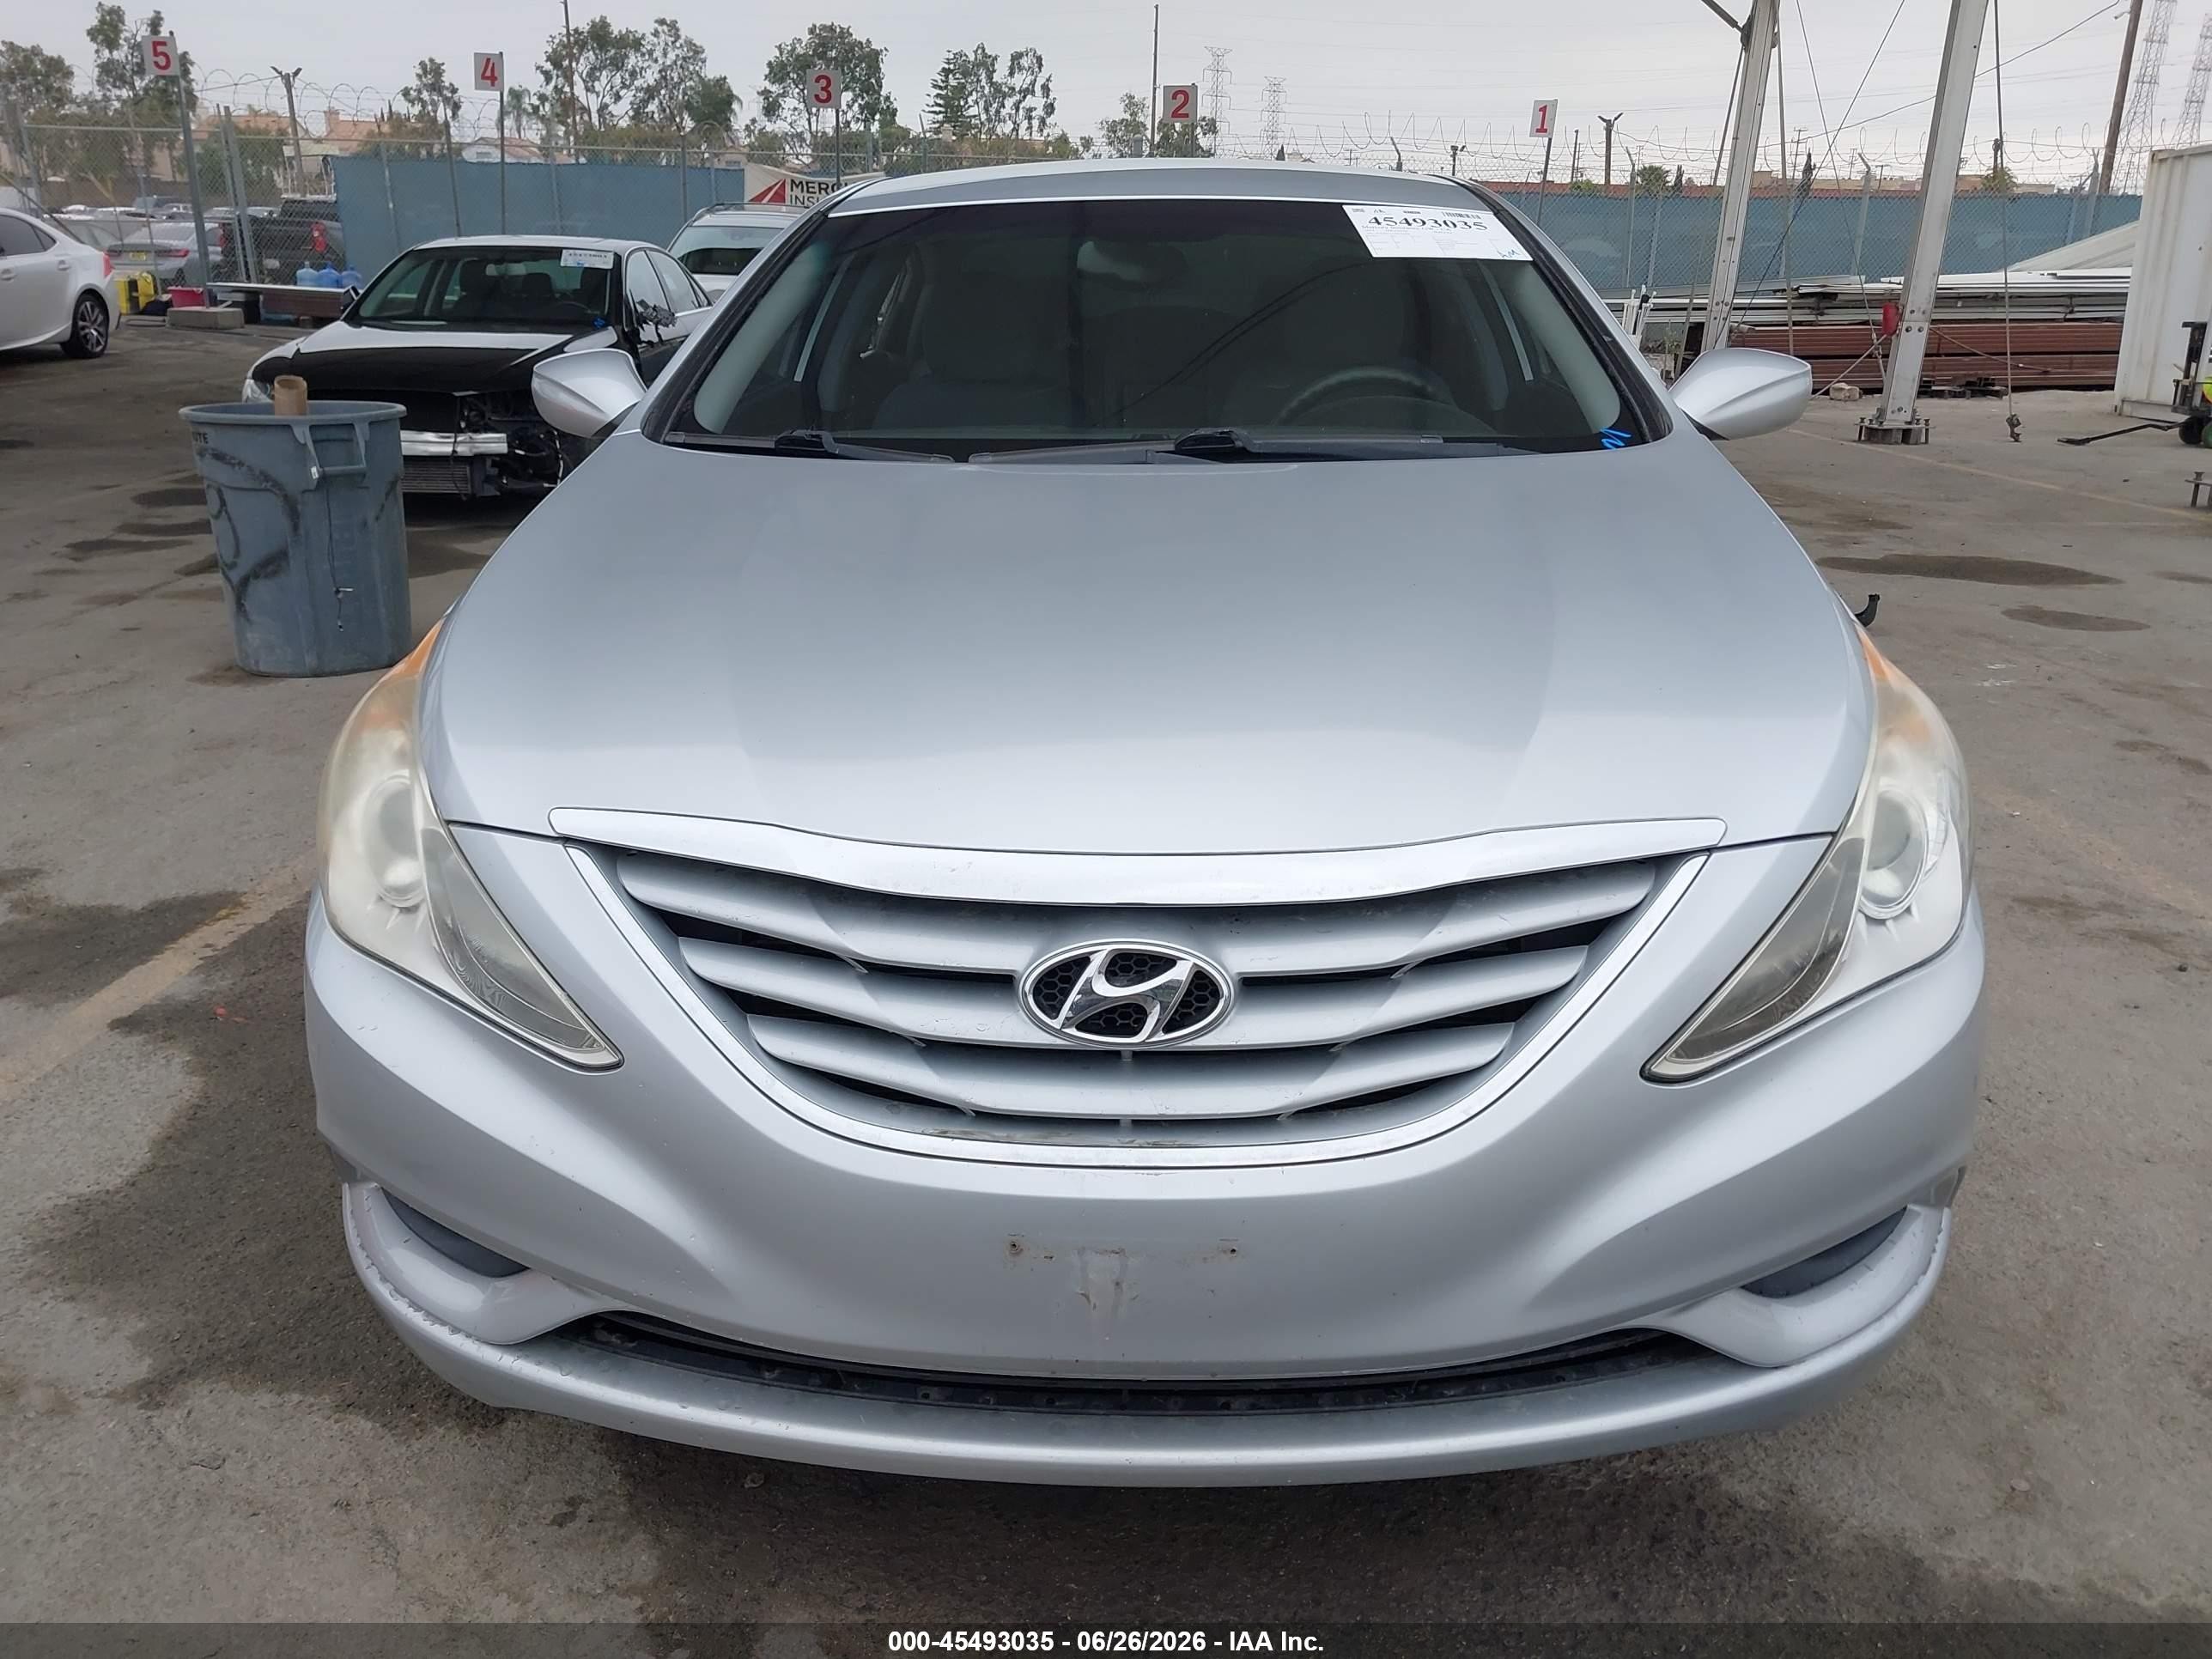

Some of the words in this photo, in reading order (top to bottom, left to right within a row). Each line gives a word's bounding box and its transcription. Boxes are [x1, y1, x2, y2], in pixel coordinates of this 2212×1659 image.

[151, 40, 172, 70] 5
[481, 58, 498, 87] 4
[814, 75, 832, 104] 3
[1171, 89, 1189, 118] 2
[1534, 105, 1547, 133] 1
[790, 179, 848, 196] MERC
[1368, 216, 1488, 232] 45493035
